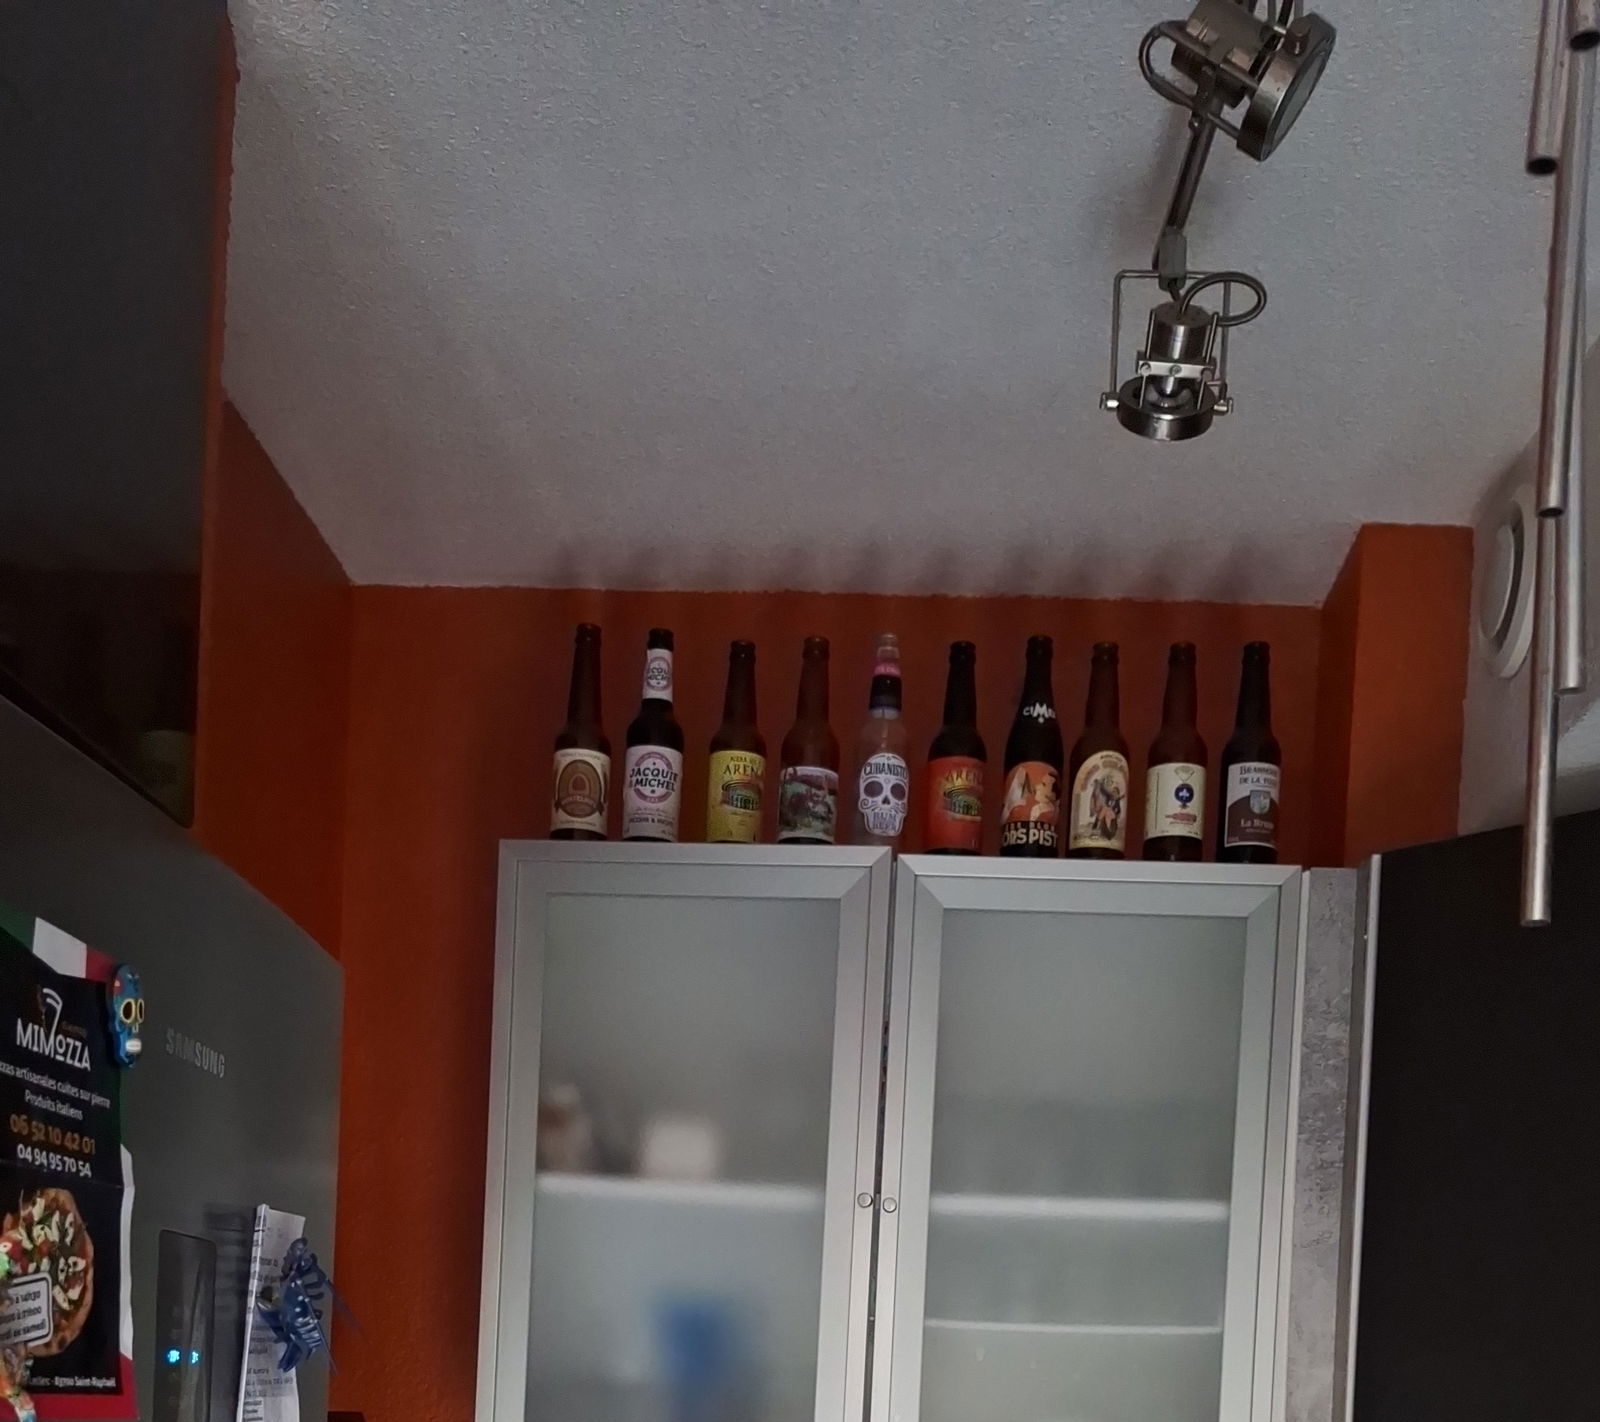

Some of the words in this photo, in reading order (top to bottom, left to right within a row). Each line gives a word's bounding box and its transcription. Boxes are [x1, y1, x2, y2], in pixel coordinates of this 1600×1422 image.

[630, 767, 678, 782] JACQUIE
[634, 778, 675, 792] MICHEL
[16, 1017, 92, 1072] MIMOZZA
[166, 1027, 225, 1079] SAMSUNG
[16, 1067, 58, 1090] artisanales
[25, 1089, 57, 1113] Produits
[57, 1100, 84, 1121] italiens
[17, 1143, 32, 1164] 04
[34, 1147, 48, 1168] 94
[62, 1156, 77, 1173] 70
